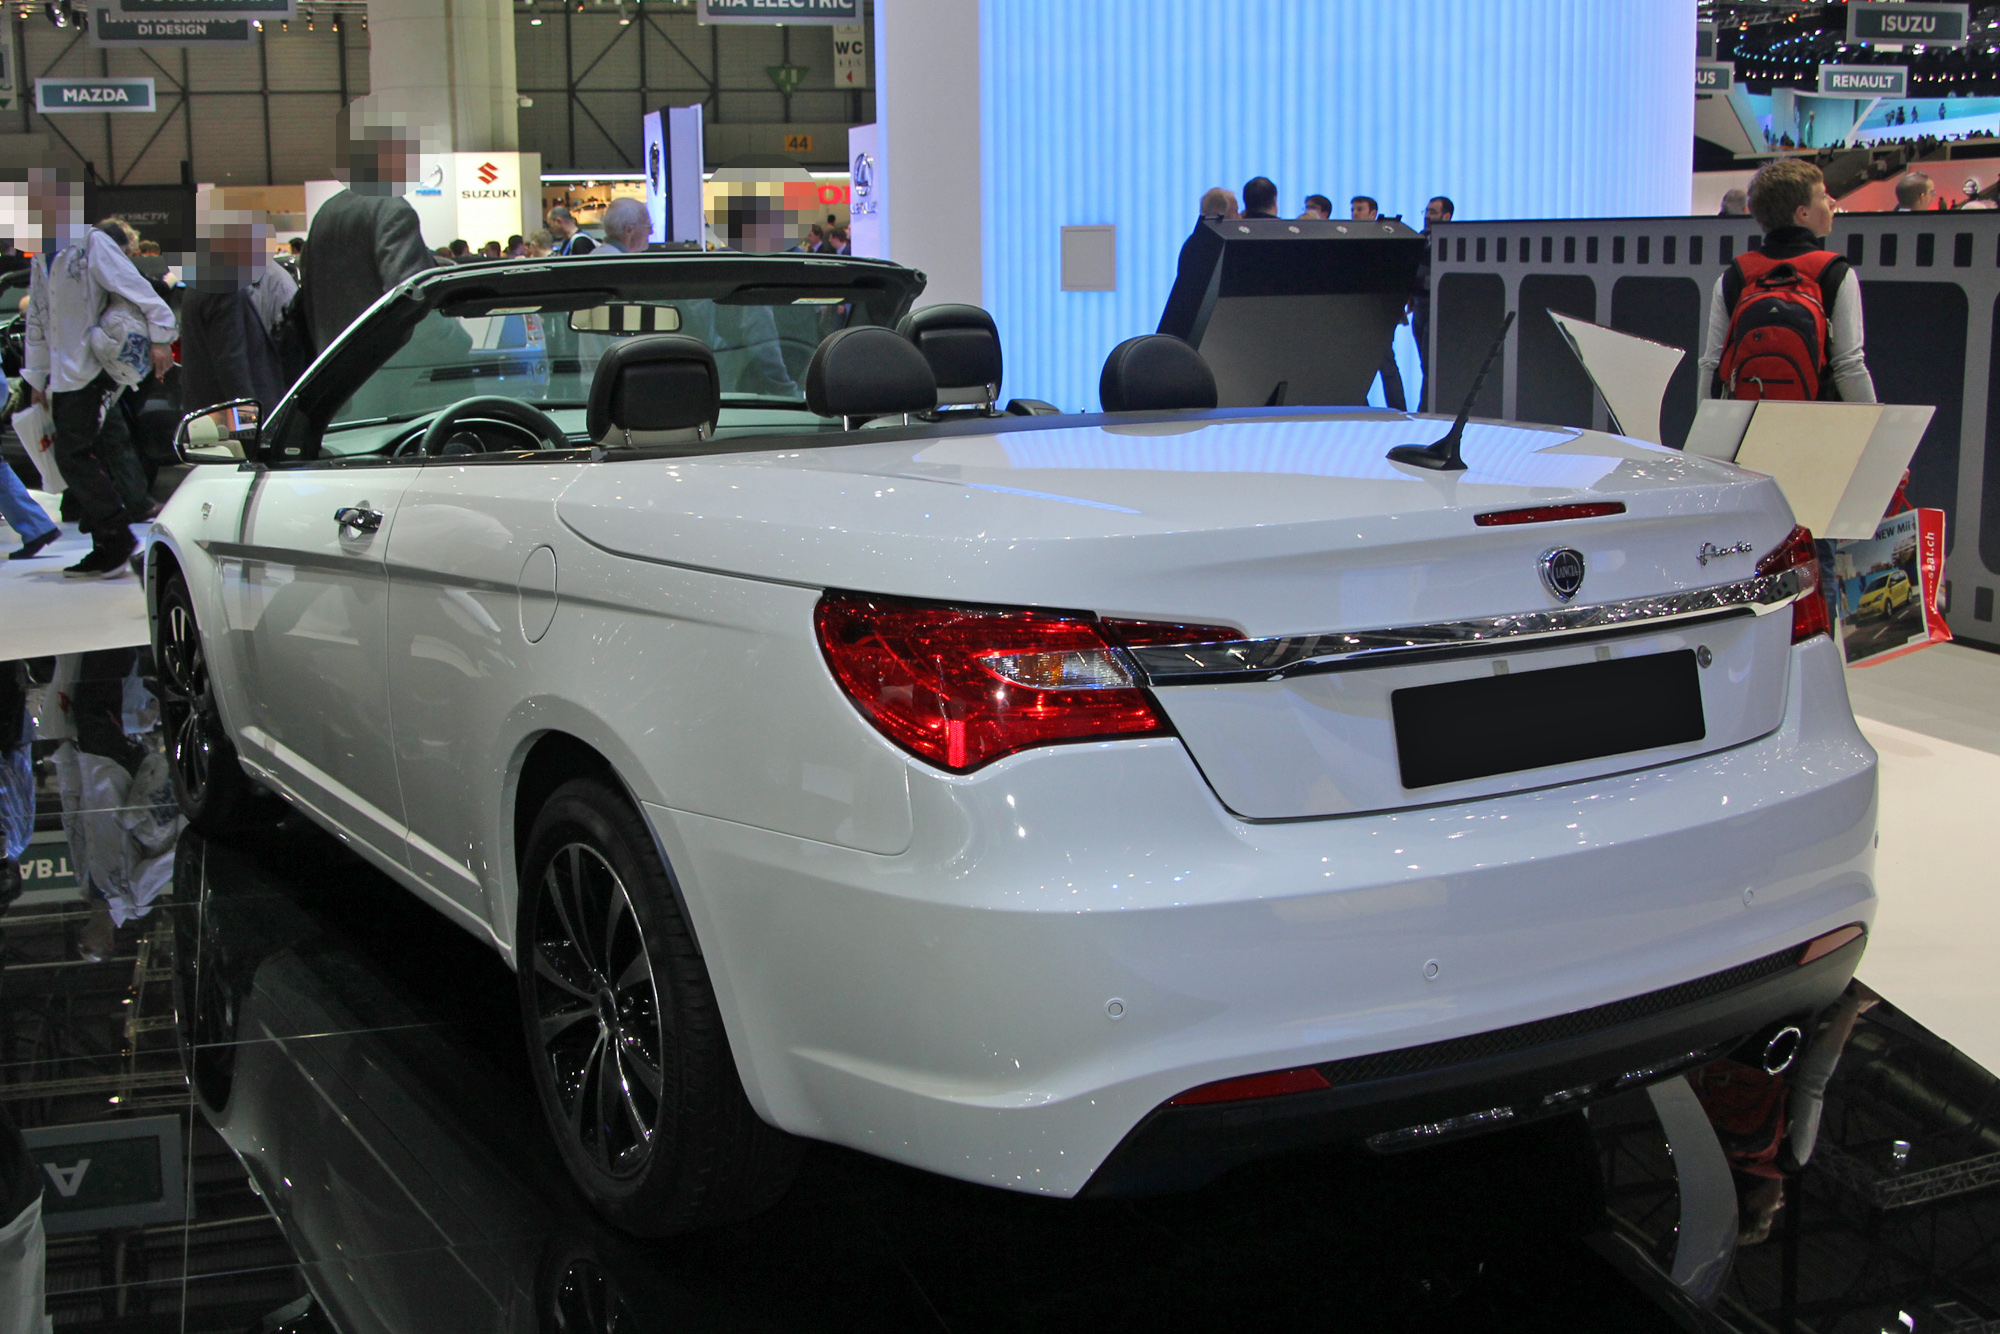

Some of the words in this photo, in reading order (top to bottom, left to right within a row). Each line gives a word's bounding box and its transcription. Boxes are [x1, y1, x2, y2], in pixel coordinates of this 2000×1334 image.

[137, 24, 152, 35] DI
[156, 24, 207, 35] DESIGN
[1881, 15, 1936, 33] ISUZU
[835, 41, 864, 55] WC
[1832, 75, 1895, 89] RENAULT
[62, 88, 129, 102] MAZDA
[788, 136, 809, 149] 44
[461, 190, 517, 198] SUZUKI
[1875, 526, 1895, 541] NEW
[1555, 564, 1579, 579] LANCIA
